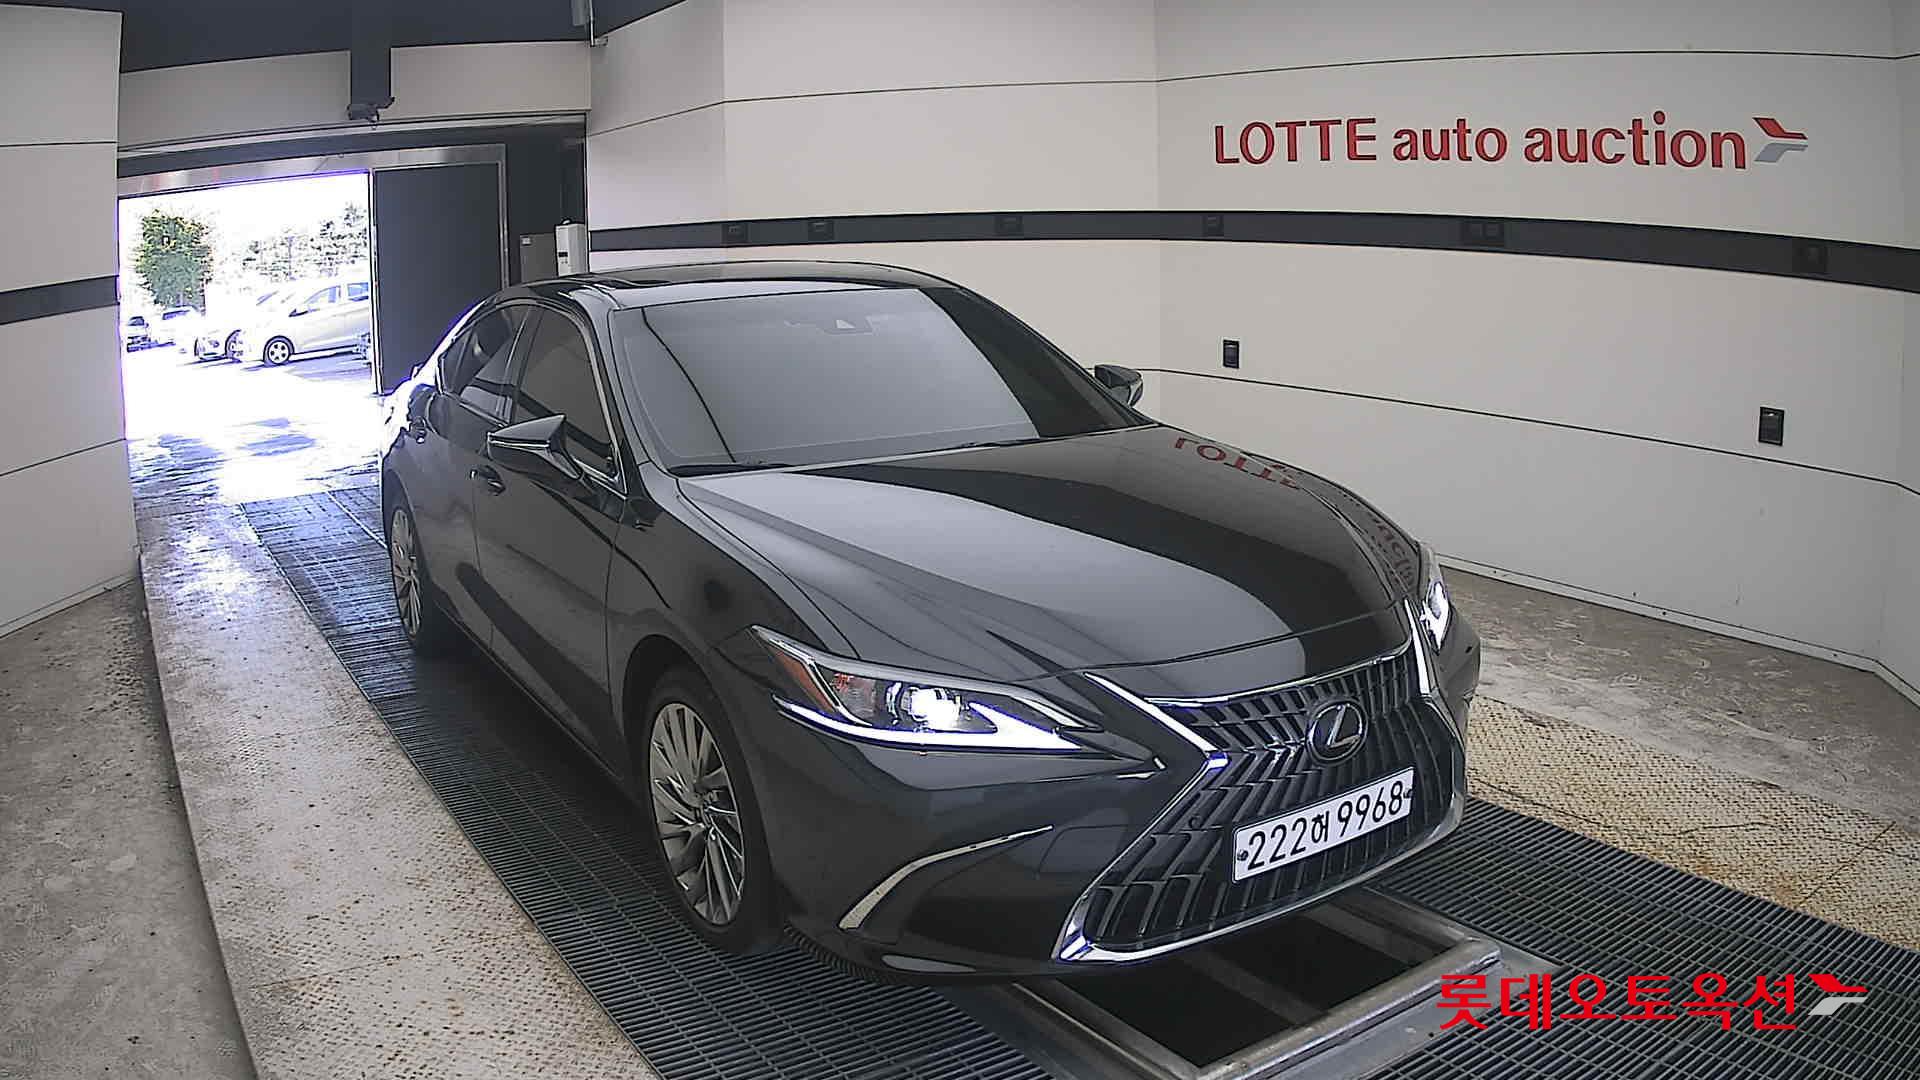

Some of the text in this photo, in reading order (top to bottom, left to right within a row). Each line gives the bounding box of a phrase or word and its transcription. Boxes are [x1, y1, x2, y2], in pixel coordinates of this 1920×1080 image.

[1214, 110, 1746, 170] LOTTE auto auction
[1247, 780, 1404, 870] 222허 9968
